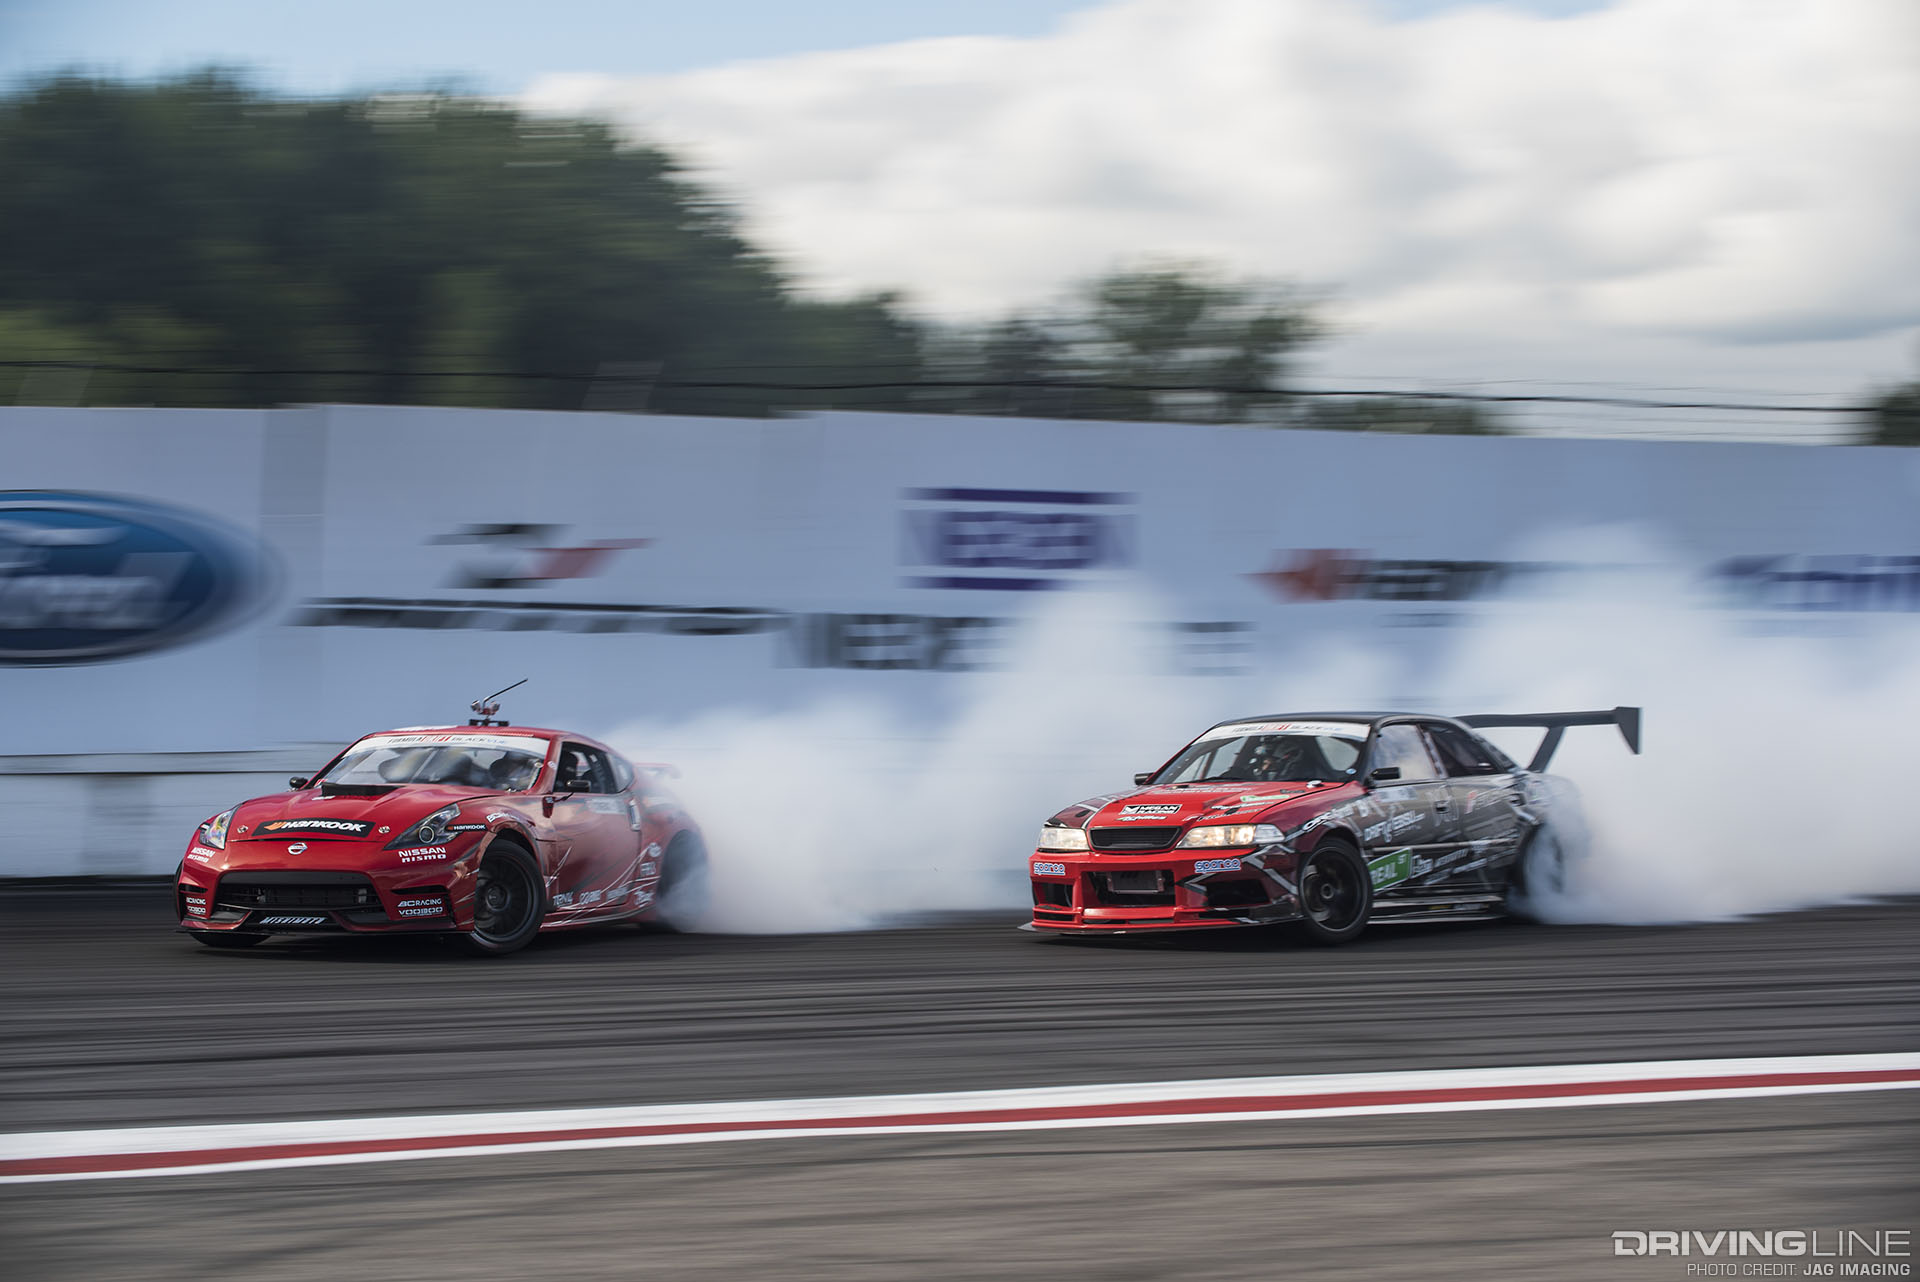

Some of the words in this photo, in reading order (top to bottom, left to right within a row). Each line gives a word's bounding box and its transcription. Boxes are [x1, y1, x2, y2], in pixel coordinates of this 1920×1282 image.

[398, 847, 446, 857] NISSAN
[1034, 863, 1065, 874] sparco
[1195, 859, 1241, 873] sparco
